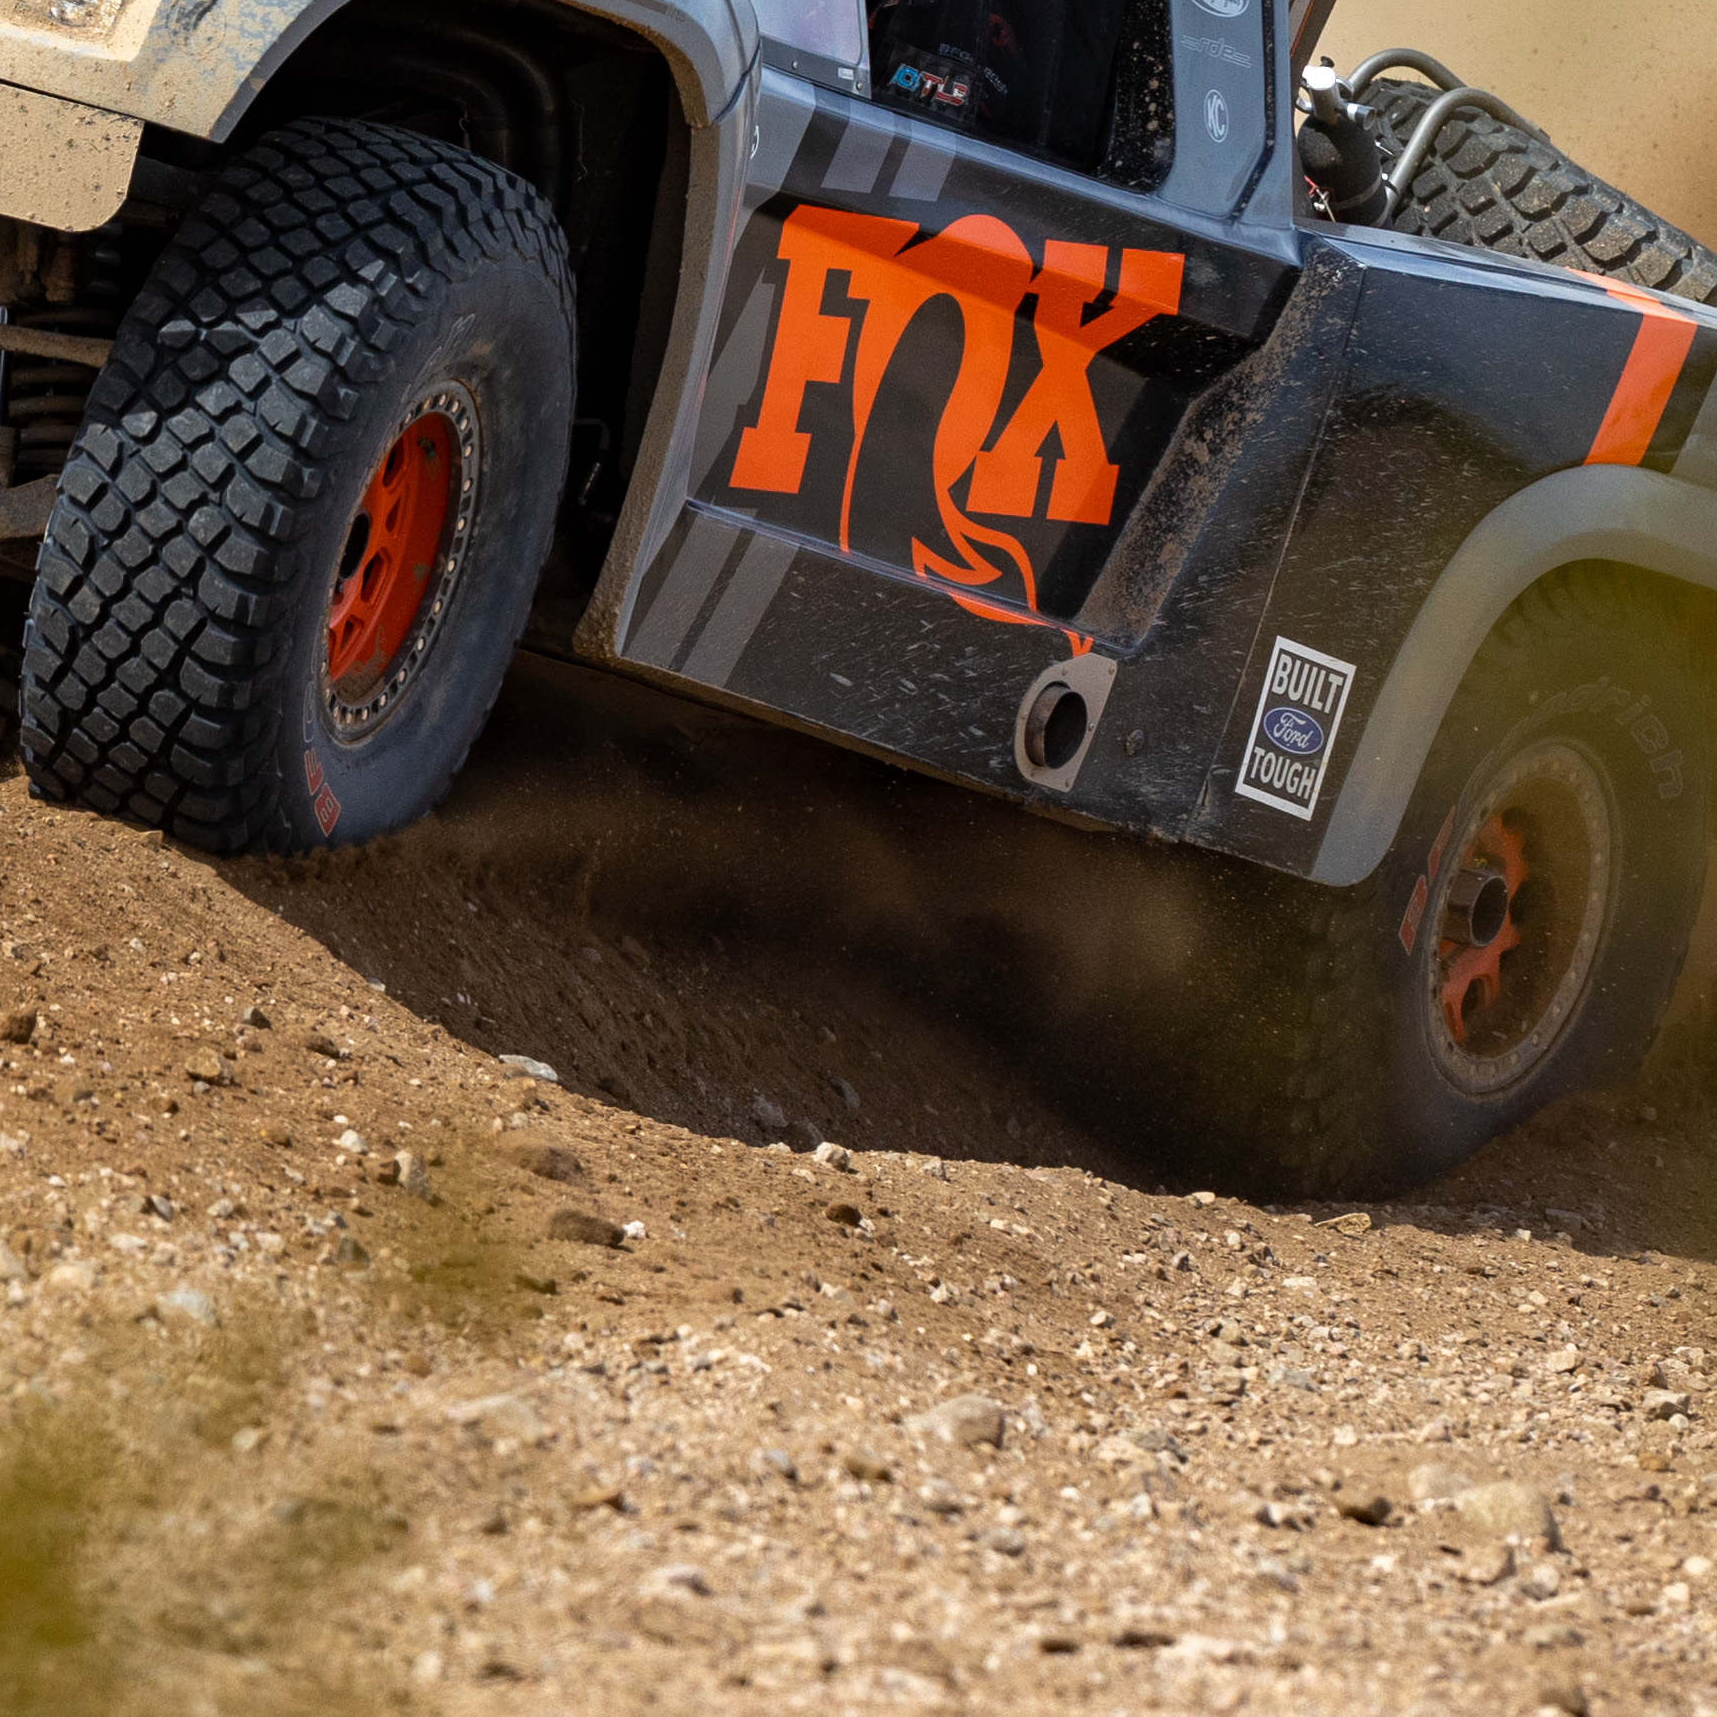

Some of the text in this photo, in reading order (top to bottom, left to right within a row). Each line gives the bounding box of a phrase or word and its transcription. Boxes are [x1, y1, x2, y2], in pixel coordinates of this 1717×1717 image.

[1207, 94, 1225, 137] KC
[729, 204, 1184, 657] FOX
[1271, 654, 1344, 714] BUILT
[1273, 712, 1313, 749] Ford
[1250, 747, 1318, 800] TOUGH
